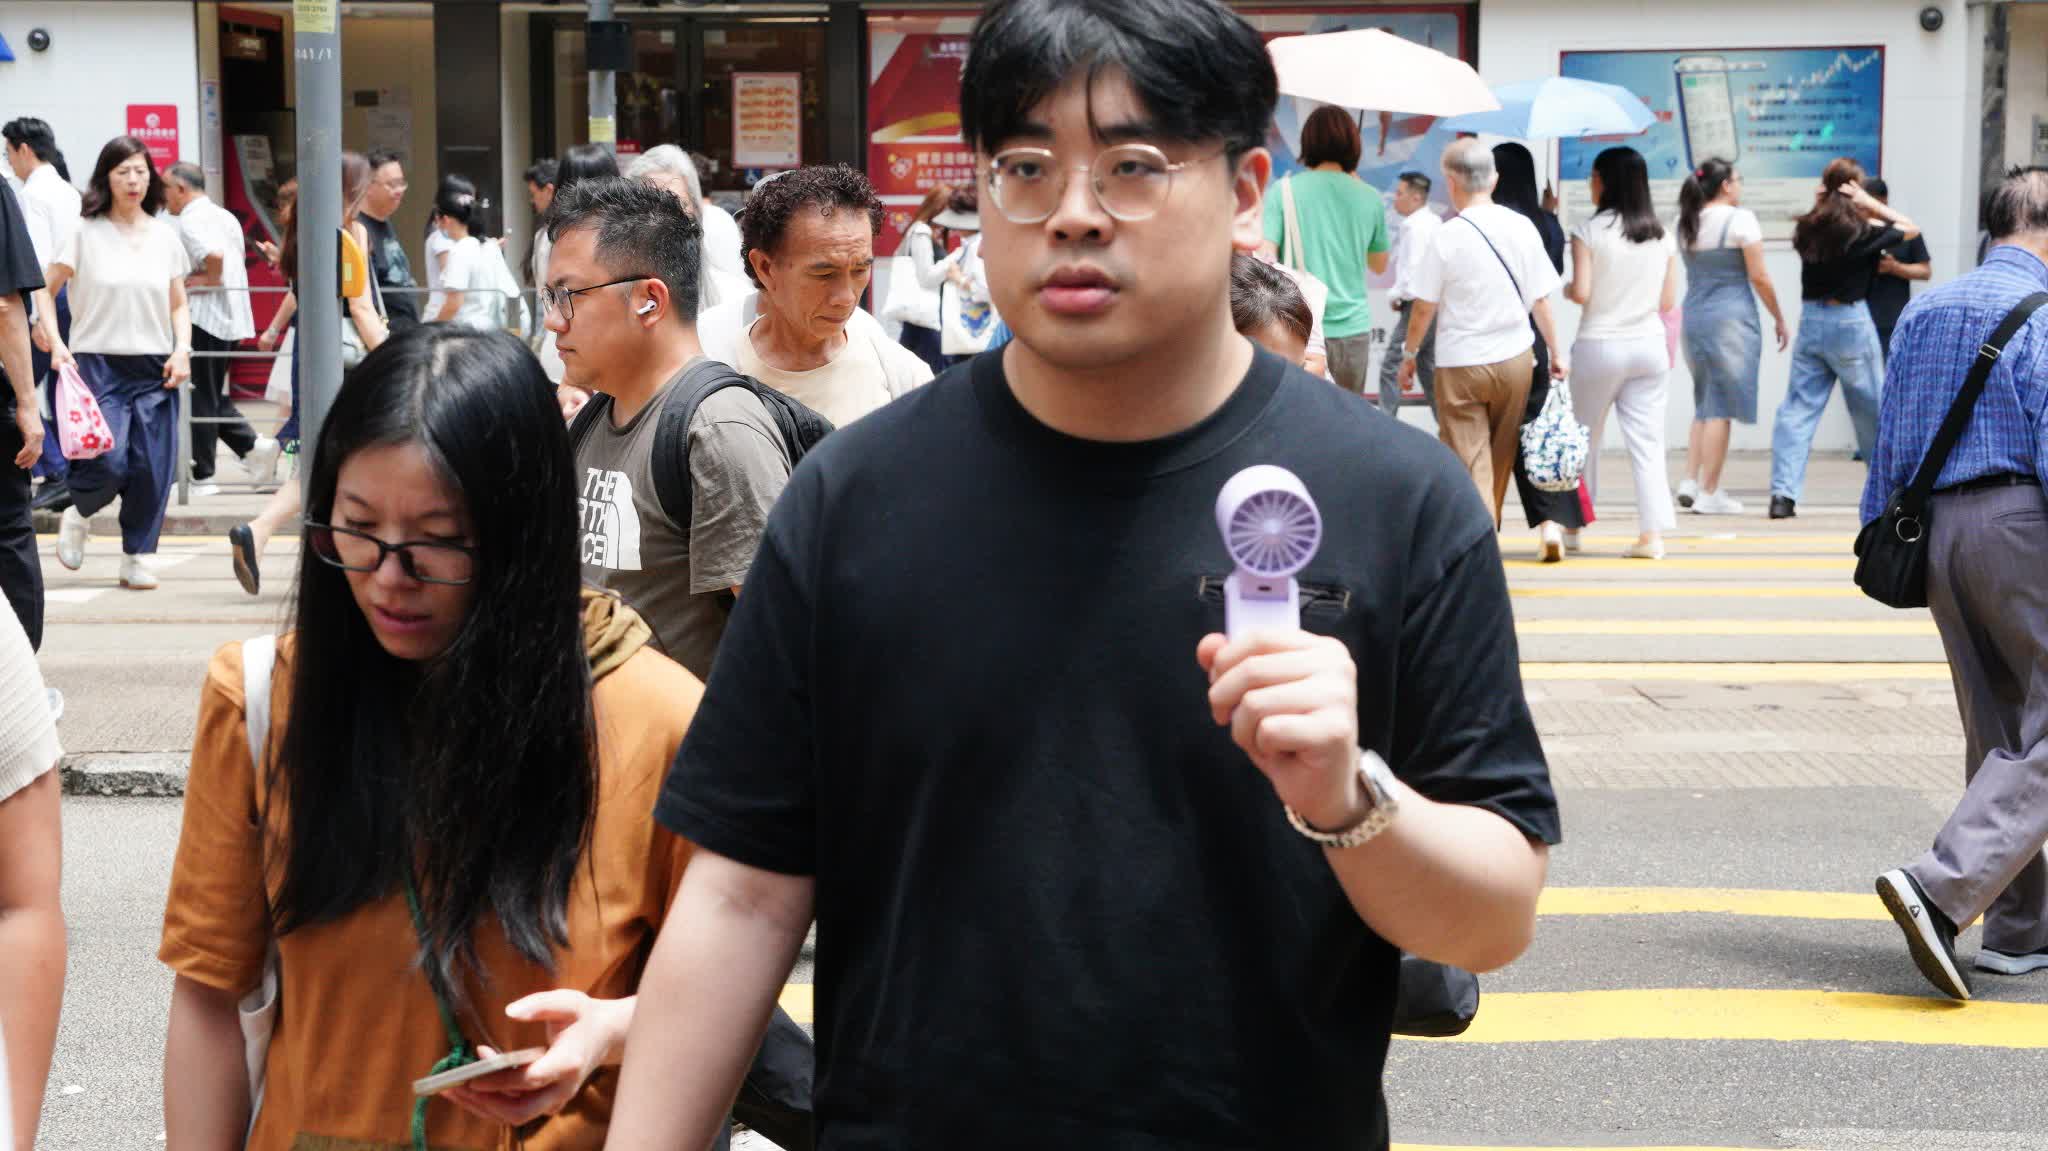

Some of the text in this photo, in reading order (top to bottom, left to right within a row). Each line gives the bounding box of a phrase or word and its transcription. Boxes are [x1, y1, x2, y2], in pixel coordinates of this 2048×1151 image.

[583, 467, 617, 502] THE
[578, 497, 609, 535] RTH
[581, 532, 608, 567] CE
